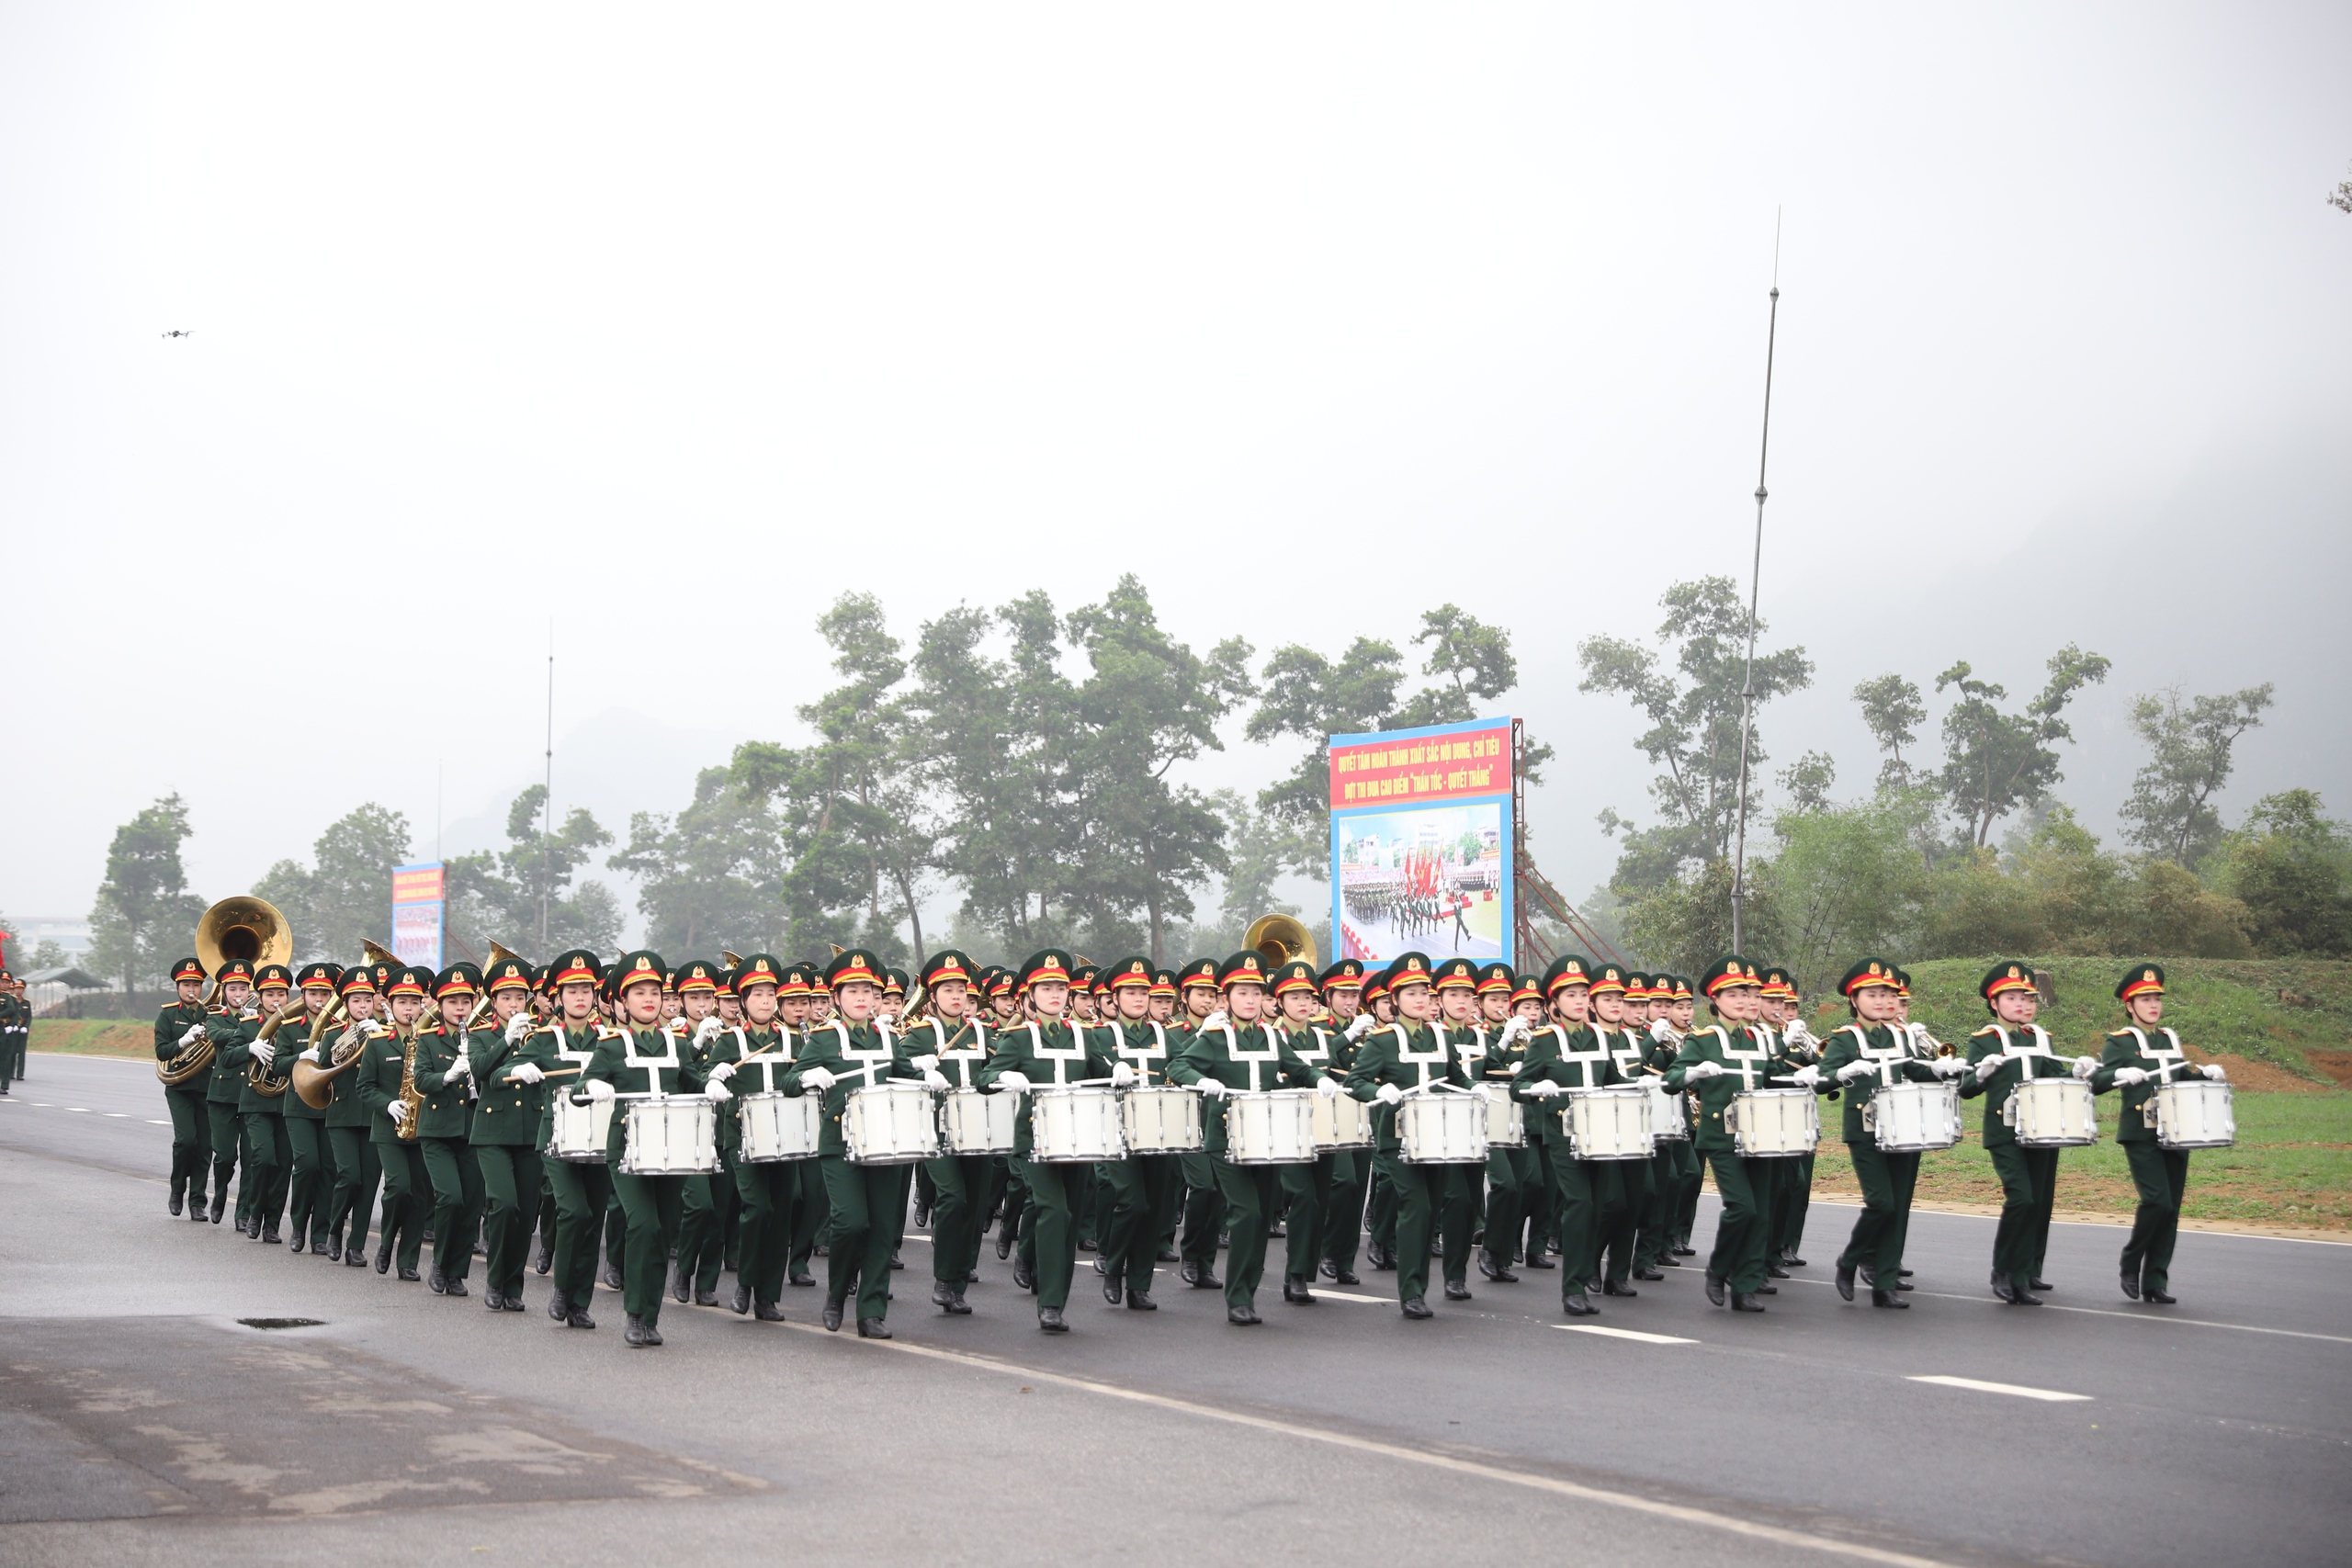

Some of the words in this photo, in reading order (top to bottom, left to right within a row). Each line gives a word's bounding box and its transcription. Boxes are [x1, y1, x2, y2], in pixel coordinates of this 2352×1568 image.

[1338, 750, 1356, 774] QUYẾT
[1358, 751, 1370, 771] TÂM
[1372, 749, 1387, 768] HOÀN
[1389, 747, 1408, 767] THÀNH
[1410, 741, 1425, 765] XUẤT
[1427, 740, 1439, 762] SẮC
[1441, 741, 1451, 764] NỘI
[1453, 742, 1472, 760] DUNG,
[1473, 734, 1484, 757] CHỈ
[1486, 735, 1499, 756] TIÊU
[1357, 782, 1366, 798] THI
[1380, 779, 1392, 796] CAO
[1431, 768, 1442, 790] TỐC
[1448, 766, 1467, 791] QUYẾT
